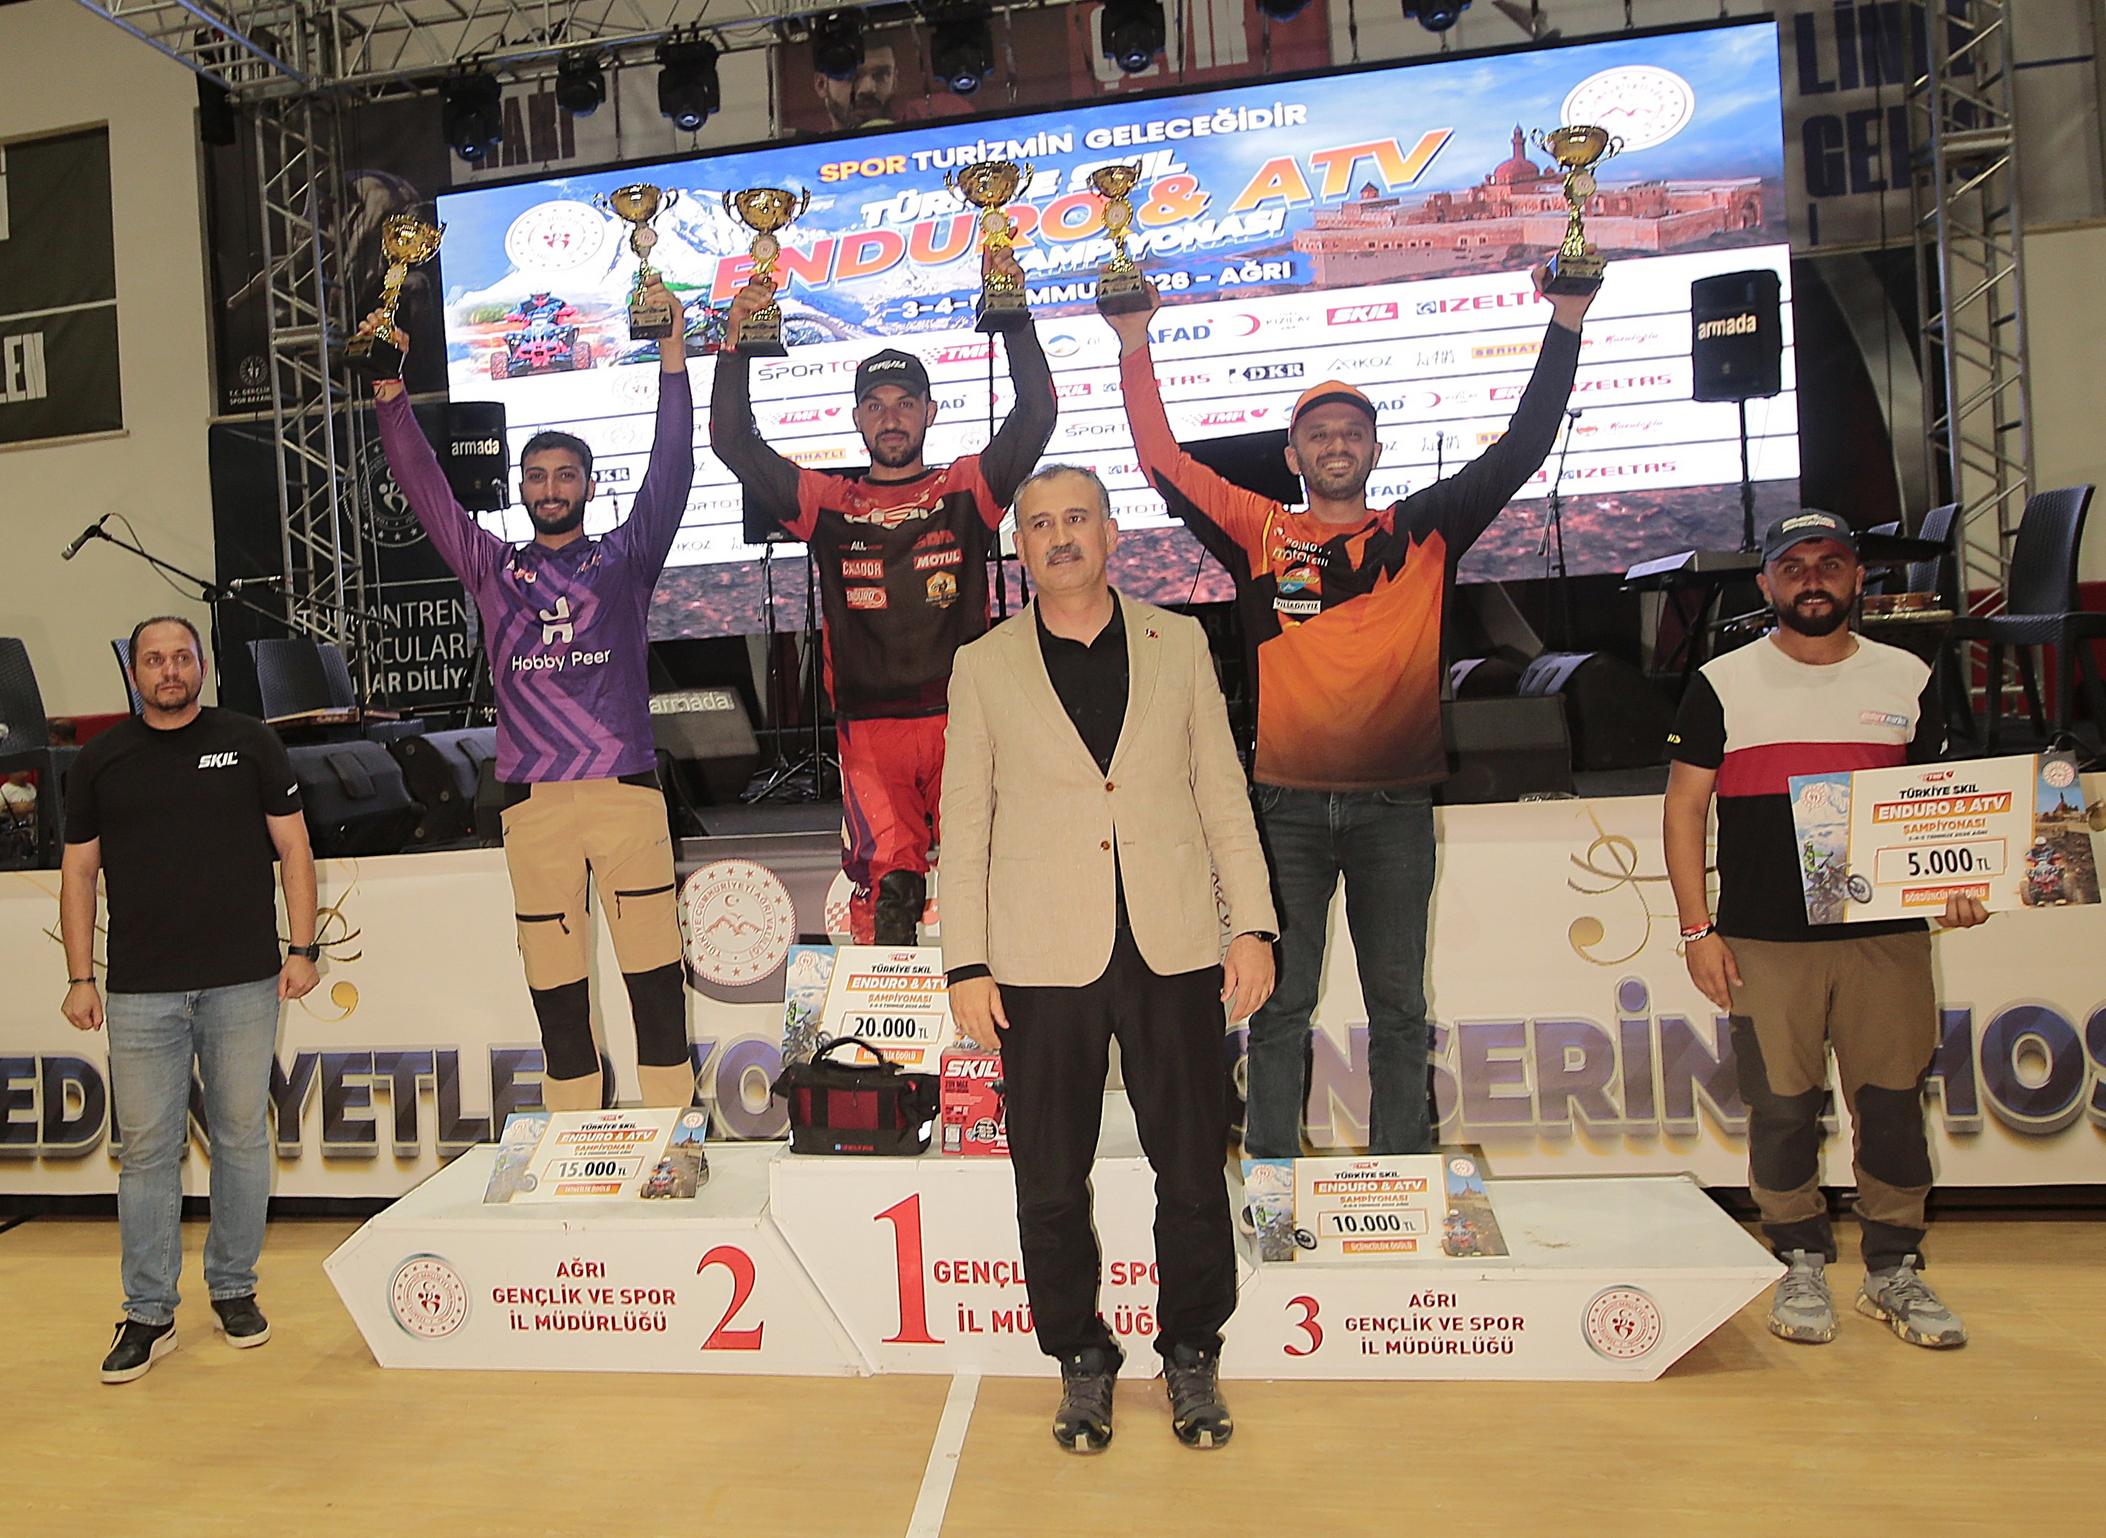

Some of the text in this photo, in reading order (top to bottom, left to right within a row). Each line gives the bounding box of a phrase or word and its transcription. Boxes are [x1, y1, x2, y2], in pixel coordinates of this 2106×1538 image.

[819, 102, 1308, 183] SPOR TURİZMİN GELECEĞİDİR
[862, 149, 1187, 228] TÜRE SIL
[1137, 174, 1208, 227] &
[1229, 128, 1454, 212] ATV
[1020, 208, 1286, 272] AMPYONASI
[1025, 282, 1096, 305] MMU
[1145, 271, 1190, 292] 26
[1219, 261, 1292, 285] AĞRI
[1440, 290, 1543, 313] IZELT
[1331, 304, 1395, 323] SKIL
[1699, 314, 1757, 339] armada
[1474, 343, 1538, 357] SERHAT
[758, 361, 863, 382] SPORTO
[939, 398, 965, 410] AD
[1376, 400, 1404, 411] AD
[1065, 423, 1127, 437] SPORT
[452, 438, 499, 455] armada
[1370, 484, 1409, 497] FAD
[915, 551, 961, 569] MOTUL
[512, 649, 611, 672] Hobby Peer
[408, 664, 471, 692] DİLİY
[649, 692, 730, 714] armada
[198, 752, 238, 768] SKIL
[1899, 784, 1979, 799] TÜRKİYE SKIL
[1878, 795, 2007, 820] ENDURO & ATV
[1908, 848, 1991, 876] 5.000 TL
[851, 976, 948, 990] ENDURO & ATV
[854, 1017, 928, 1039] 20.000 TL
[945, 1060, 1000, 1079] SKIL
[561, 1131, 653, 1143] ENDURO & ATV
[560, 1161, 626, 1177] 15.000 TL
[1319, 1180, 1422, 1192] ENDURO & ATV
[1333, 1214, 1416, 1233] 10.000 TL
[556, 1257, 606, 1277] AĞRI
[873, 1192, 945, 1344] 1
[933, 1260, 1160, 1287] GENÇL SP
[493, 1284, 676, 1307] GENÇLİK VE SPOR
[696, 1245, 764, 1350] 2
[1408, 1289, 1457, 1308] AĞRI
[510, 1310, 667, 1332] İL MÜDÜRLÜĞÜ
[958, 1303, 983, 1332] İL
[1282, 1294, 1324, 1356] 3
[1345, 1312, 1525, 1335] GENÇLİK VE SPOR
[1361, 1336, 1514, 1355] İL MÜDÜRLÜĞÜ
